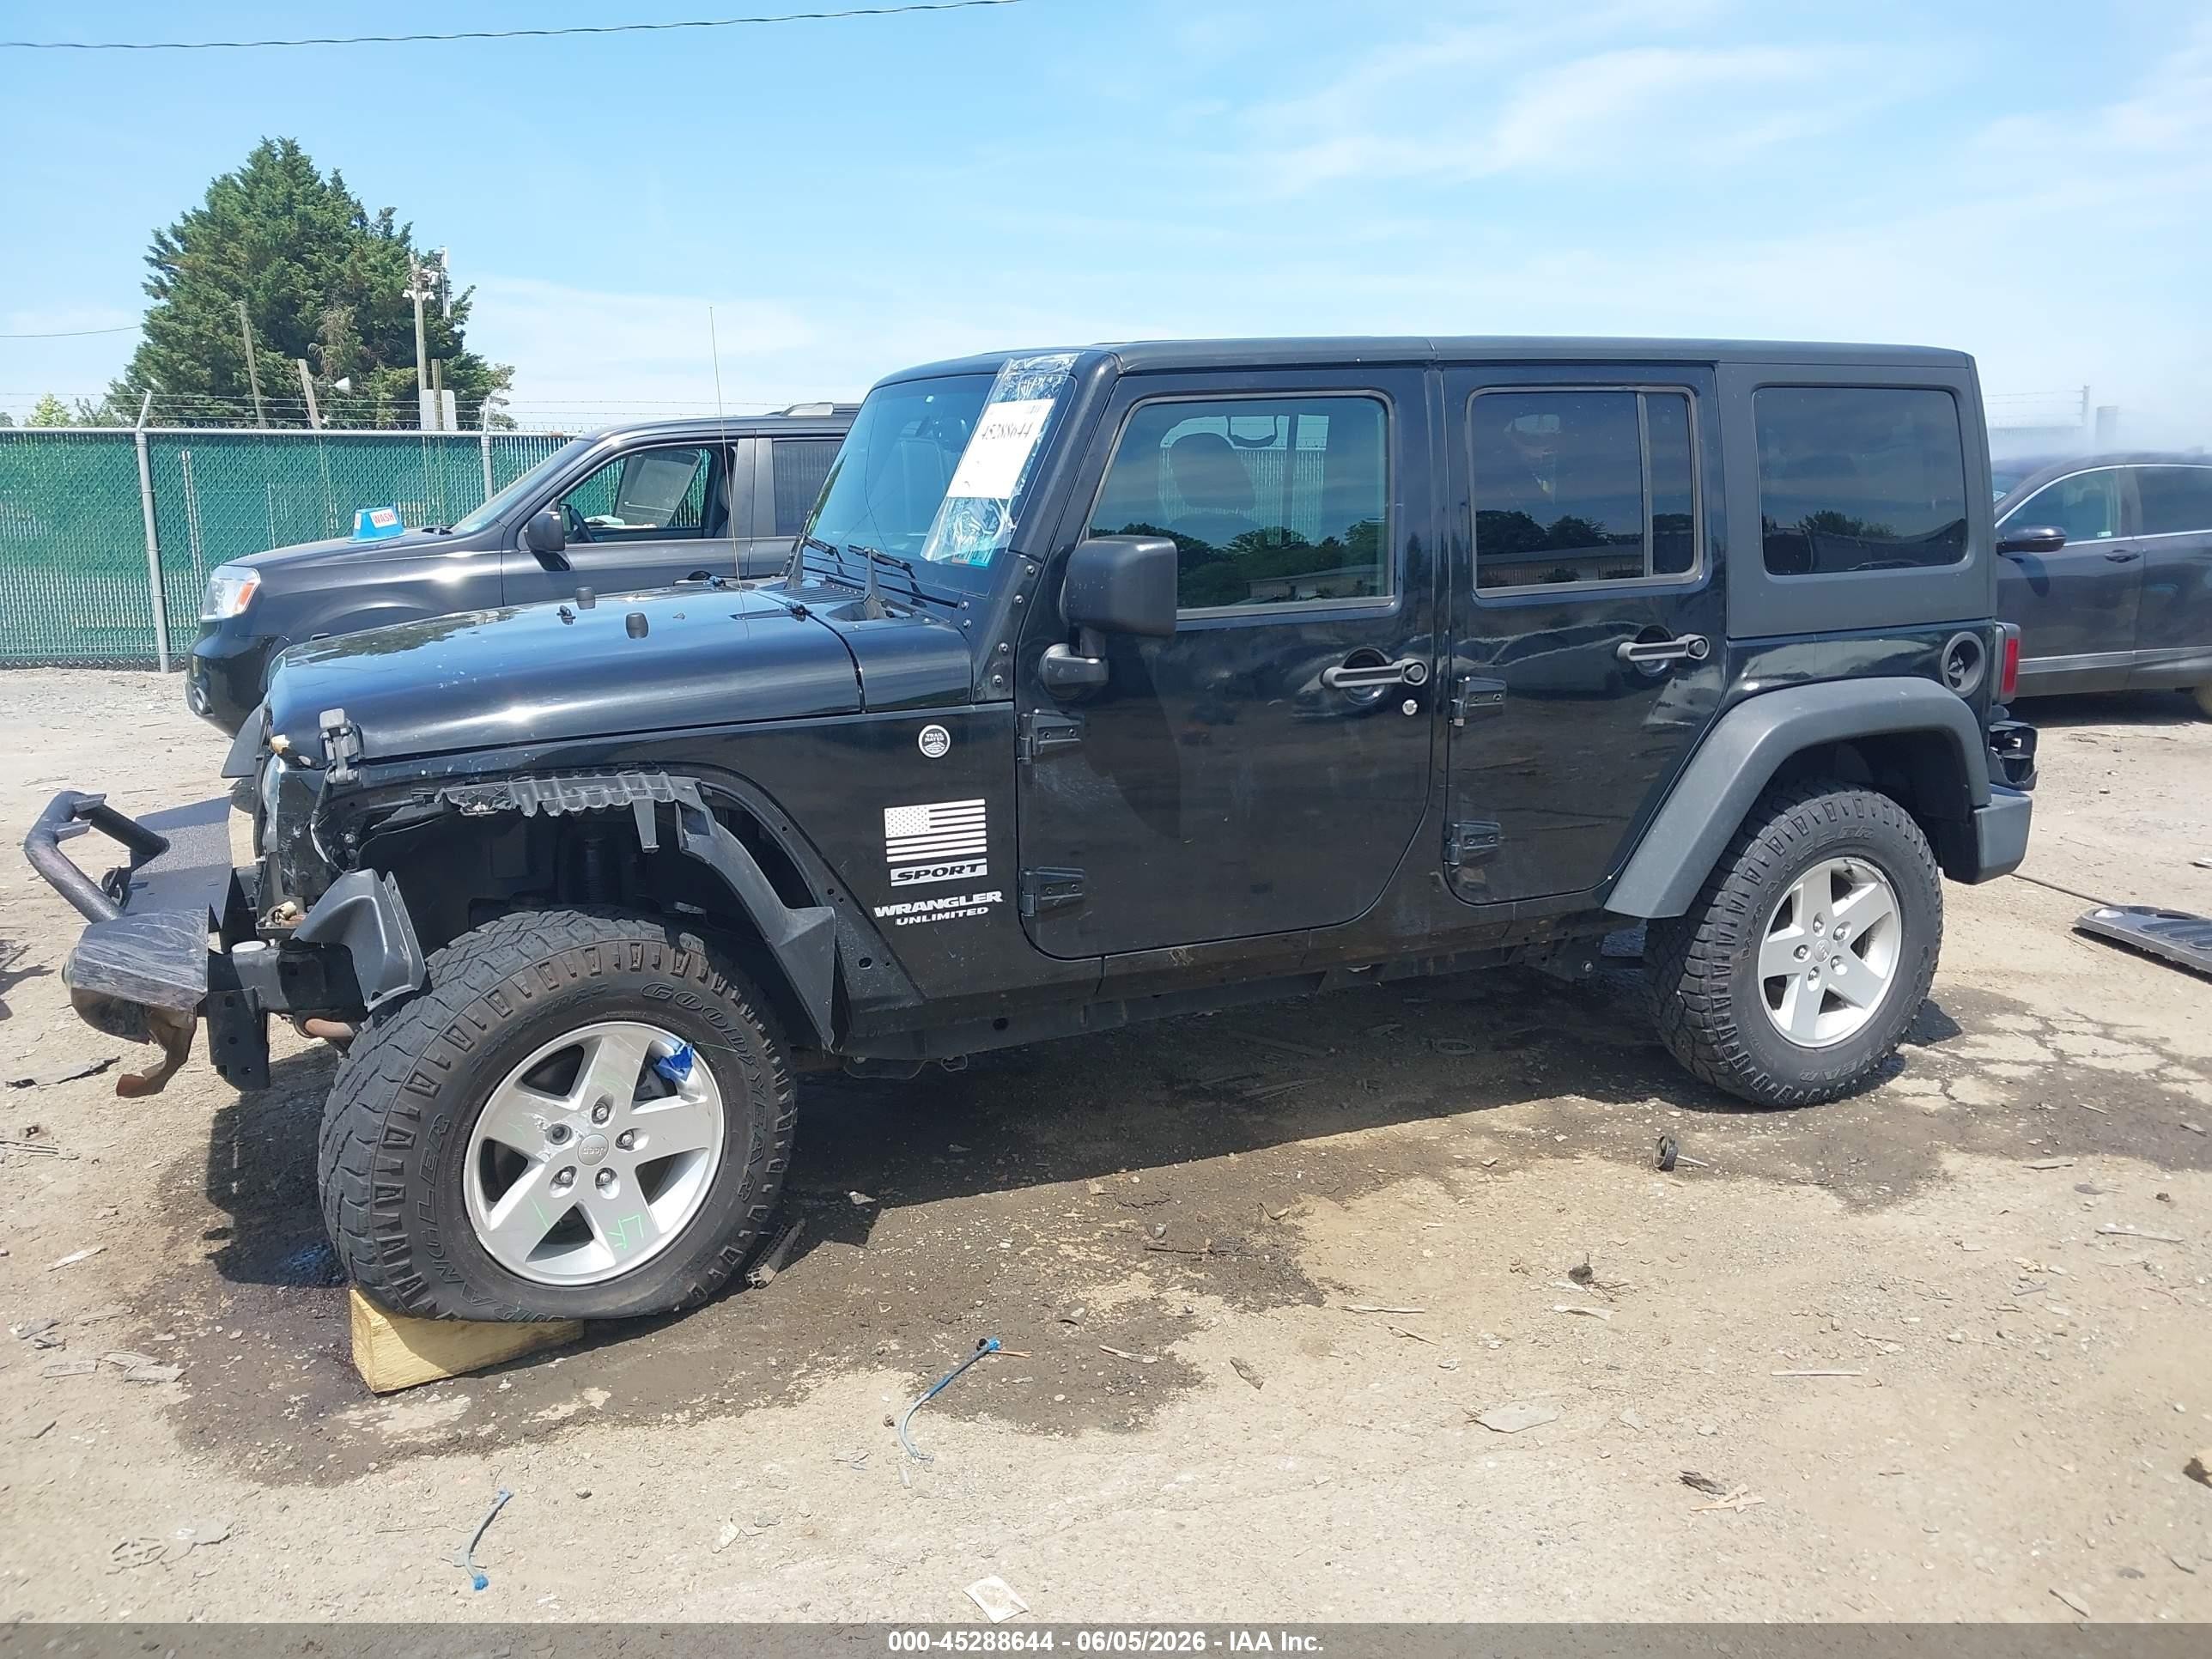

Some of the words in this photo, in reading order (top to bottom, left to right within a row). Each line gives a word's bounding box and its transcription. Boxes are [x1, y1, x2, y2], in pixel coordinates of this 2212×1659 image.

[374, 513, 394, 524] WASH
[897, 864, 980, 881] SPORT
[874, 890, 1003, 917] WRANGLER
[896, 907, 989, 926] UNLIMITED
[640, 981, 768, 1202] GOODYEAR
